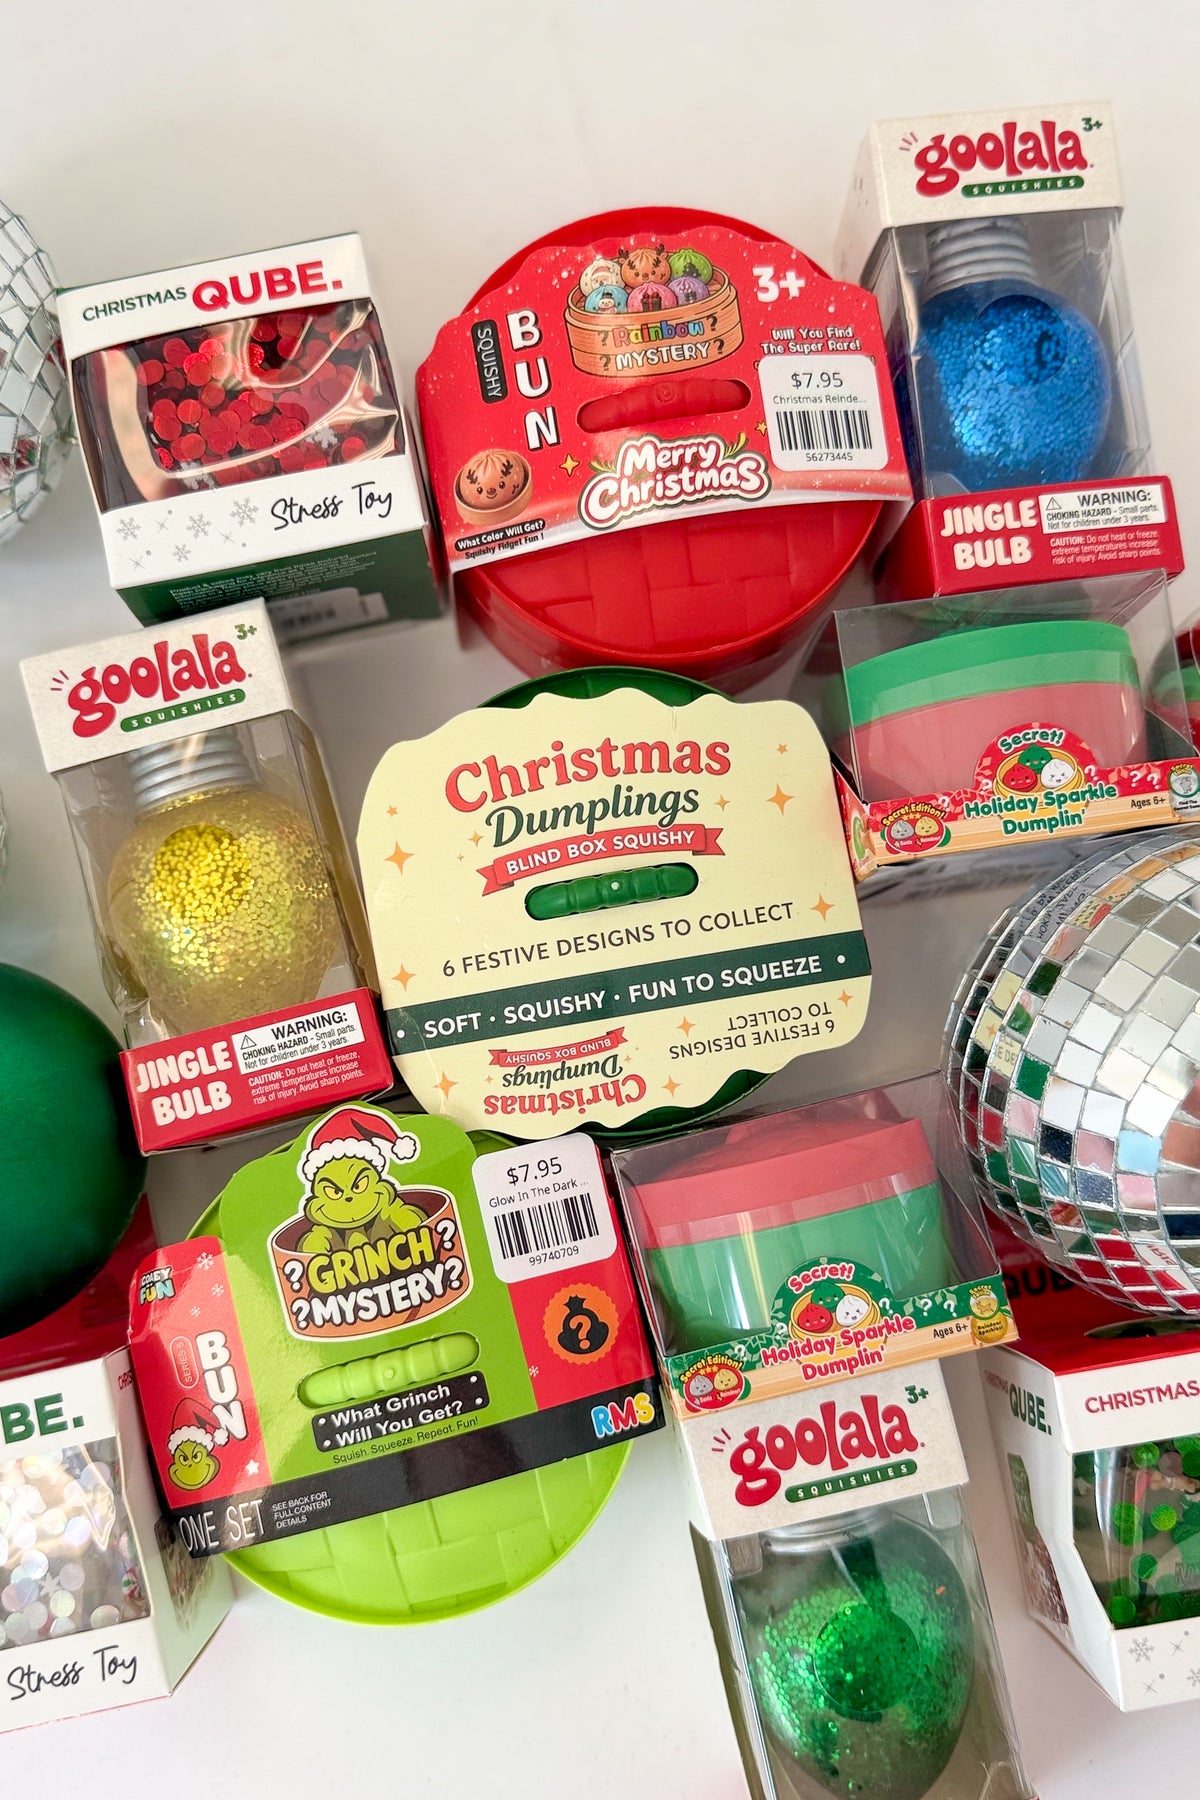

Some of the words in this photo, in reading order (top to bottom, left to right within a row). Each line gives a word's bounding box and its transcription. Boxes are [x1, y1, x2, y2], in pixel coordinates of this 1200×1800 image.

[1081, 117, 1102, 132] 3+
[914, 120, 1088, 198] goolala
[973, 179, 1076, 195] SQUISHIES
[82, 287, 187, 322] CHRISTMAS
[193, 260, 343, 312] QUBE.
[752, 266, 806, 303] 3+
[612, 320, 705, 347] Rainbow
[761, 343, 784, 354] The
[788, 342, 823, 354] Super
[827, 340, 861, 351] Rare!
[772, 329, 795, 340] Will
[799, 328, 823, 339] You
[827, 327, 854, 338] Find
[478, 328, 502, 398] SQUISHY
[615, 341, 710, 371] MYSTERY
[506, 309, 561, 451] BUN
[791, 372, 844, 390] $7.95
[773, 395, 822, 404] Christmas
[622, 438, 716, 478] Merry
[806, 452, 853, 462] 56273445
[271, 494, 343, 530] Stress
[352, 482, 393, 519] Toy
[583, 460, 763, 526] Christmas
[1077, 490, 1151, 507] WARNING:
[940, 500, 1038, 537] JINGLE
[1046, 510, 1080, 521] CHOKING
[1081, 507, 1112, 517] HAZARD
[1119, 505, 1138, 514] Small
[1047, 521, 1060, 530] Not
[1061, 521, 1072, 529] for
[1073, 517, 1101, 528] children
[1101, 516, 1122, 525] under
[1123, 515, 1129, 523] 3
[457, 537, 480, 550] What
[481, 532, 504, 543] Color
[505, 526, 523, 537] Will
[524, 520, 544, 532] Get?
[465, 546, 496, 559] Squishy
[498, 538, 522, 551] Fidget
[524, 534, 539, 544] Fun
[954, 536, 1032, 571] BULB
[235, 624, 257, 640] 3+
[68, 634, 246, 738] goolala
[131, 693, 237, 728] SQUISHIES
[1000, 729, 1064, 752] Secret!
[445, 737, 731, 812] Christmas
[882, 804, 909, 826] Secret
[910, 802, 945, 819] Edition!
[965, 795, 1039, 817] Holiday
[1043, 783, 1117, 809] Sparkle
[1130, 798, 1152, 810] Ages
[1153, 796, 1166, 805] 6+
[485, 784, 699, 847] Dumplings
[1003, 808, 1085, 834] Dumplin'
[506, 849, 561, 875] BLIND
[567, 838, 607, 859] BOX
[613, 830, 695, 850] SQUISHY
[443, 960, 455, 977] 6
[462, 944, 549, 974] FESTIVE
[556, 924, 655, 957] DESIGNS
[660, 917, 692, 939] TO
[698, 902, 794, 932] COLLECT
[424, 1012, 482, 1038] SOFT
[504, 990, 606, 1025] SQUISHY
[629, 979, 675, 1003] FUN
[682, 973, 714, 994] TO
[721, 955, 822, 988] SQUEEZE
[809, 1002, 833, 1017] TO
[271, 1011, 348, 1040] WARNING:
[727, 1006, 804, 1031] COLLECT
[825, 1019, 836, 1033] 6
[242, 1045, 276, 1061] CHOKING
[278, 1036, 309, 1051] HAZARD
[315, 1029, 336, 1041] Small
[337, 1024, 356, 1036] parts.
[579, 1037, 612, 1053] BLIND
[669, 1037, 746, 1060] DESIGNS
[753, 1024, 821, 1047] FESTIVE
[136, 1040, 233, 1093] JINGLE
[244, 1061, 257, 1070] Not
[259, 1057, 269, 1067] for
[270, 1050, 299, 1063] children
[299, 1044, 320, 1055] under
[321, 1042, 327, 1050] 3
[328, 1037, 349, 1049] years.
[505, 1051, 553, 1065] SQUISHY
[554, 1046, 577, 1058] BOX
[248, 1070, 284, 1087] CAUTION:
[285, 1067, 296, 1077] Do
[297, 1065, 309, 1074] not
[309, 1059, 326, 1071] heat
[251, 1084, 281, 1097] extreme
[281, 1070, 329, 1088] temperatures
[328, 1061, 359, 1074] increase
[502, 1054, 624, 1089] Dumplings
[152, 1081, 233, 1126] BULB
[253, 1095, 268, 1105] risk
[268, 1092, 277, 1102] of
[277, 1087, 299, 1100] injury.
[299, 1081, 319, 1092] Avoid
[320, 1076, 340, 1088] sharp
[484, 1074, 647, 1116] Christmas
[507, 1156, 562, 1186] $7.95
[489, 1195, 515, 1208] Glow
[518, 1191, 529, 1201] In
[531, 1186, 550, 1198] The
[553, 1178, 578, 1193] Dark
[306, 1227, 434, 1294] GRINCH
[529, 1245, 579, 1266] 99740709
[140, 1279, 175, 1305] FUN
[789, 1265, 853, 1292] Secret!
[310, 1267, 446, 1328] MYSTERY
[762, 1337, 835, 1366] Holiday
[840, 1315, 915, 1348] Sparkle
[933, 1326, 954, 1339] Ages
[955, 1322, 968, 1332] 6+
[680, 1358, 706, 1382] Secret
[707, 1354, 743, 1371] Edition!
[802, 1345, 885, 1380] Dumplin'
[195, 1330, 248, 1441] BUN
[905, 1385, 929, 1404] 3+
[1085, 1379, 1200, 1414] CHRISTMAS
[331, 1403, 382, 1427] What
[386, 1384, 451, 1412] Grinch
[591, 1392, 655, 1438] RMS
[1009, 1383, 1052, 1436] QUBE.
[336, 1425, 373, 1448] Will
[376, 1417, 414, 1436] You
[418, 1400, 463, 1424] Get?
[457, 1416, 479, 1430] Fun!
[730, 1395, 918, 1507] goolala
[797, 1464, 908, 1498] SQUISHIES
[272, 1501, 288, 1512] SEE
[288, 1496, 310, 1508] BACK
[310, 1491, 328, 1502] FOR
[274, 1510, 294, 1520] FULL
[294, 1498, 332, 1514] CONTENT
[179, 1511, 220, 1551] ONE
[226, 1500, 265, 1542] SET
[276, 1514, 307, 1529] DETAILS
[8, 1658, 85, 1700] Stress
[93, 1645, 137, 1684] Toy
